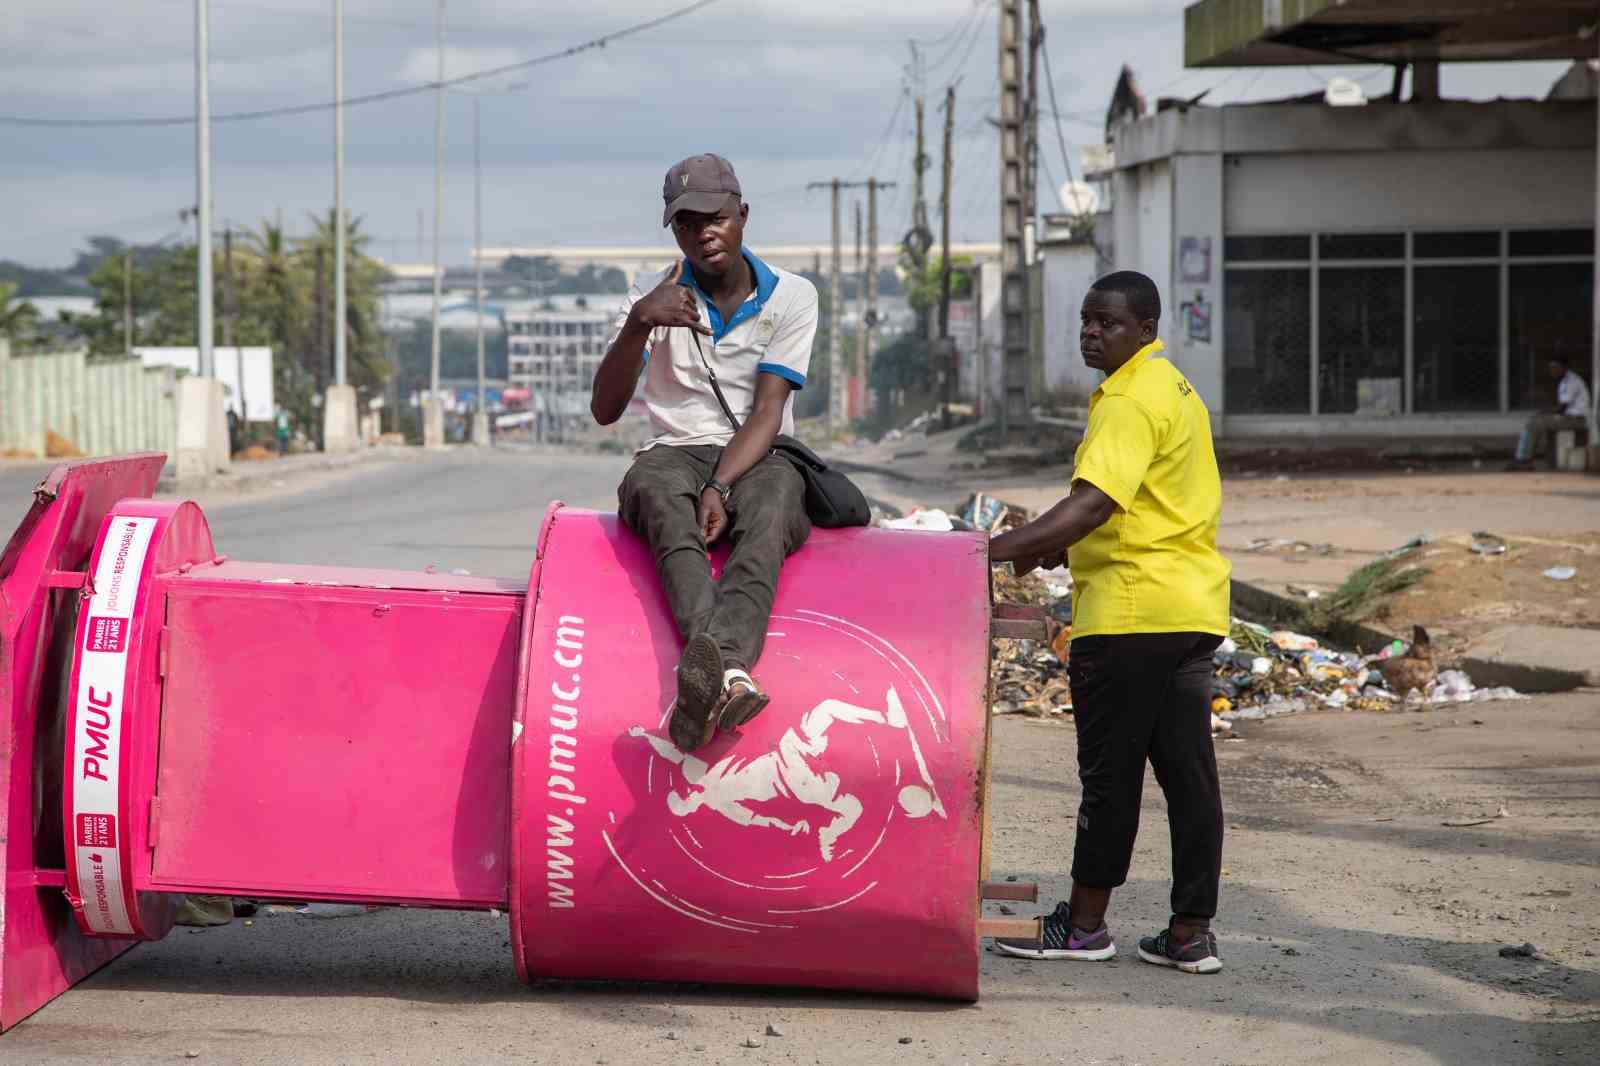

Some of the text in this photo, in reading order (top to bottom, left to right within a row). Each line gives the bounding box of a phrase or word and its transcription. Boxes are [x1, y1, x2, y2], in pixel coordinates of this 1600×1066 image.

[113, 528, 136, 574] RESPONSABLE
[94, 619, 106, 650] PARIER
[108, 619, 121, 650] 21 ANS
[83, 686, 113, 782] PMUC
[547, 615, 587, 909] www.pmuc.cm
[84, 816, 93, 845] PARIER
[98, 816, 108, 845] 21 ANS
[93, 865, 109, 912] RESPONSABLE
